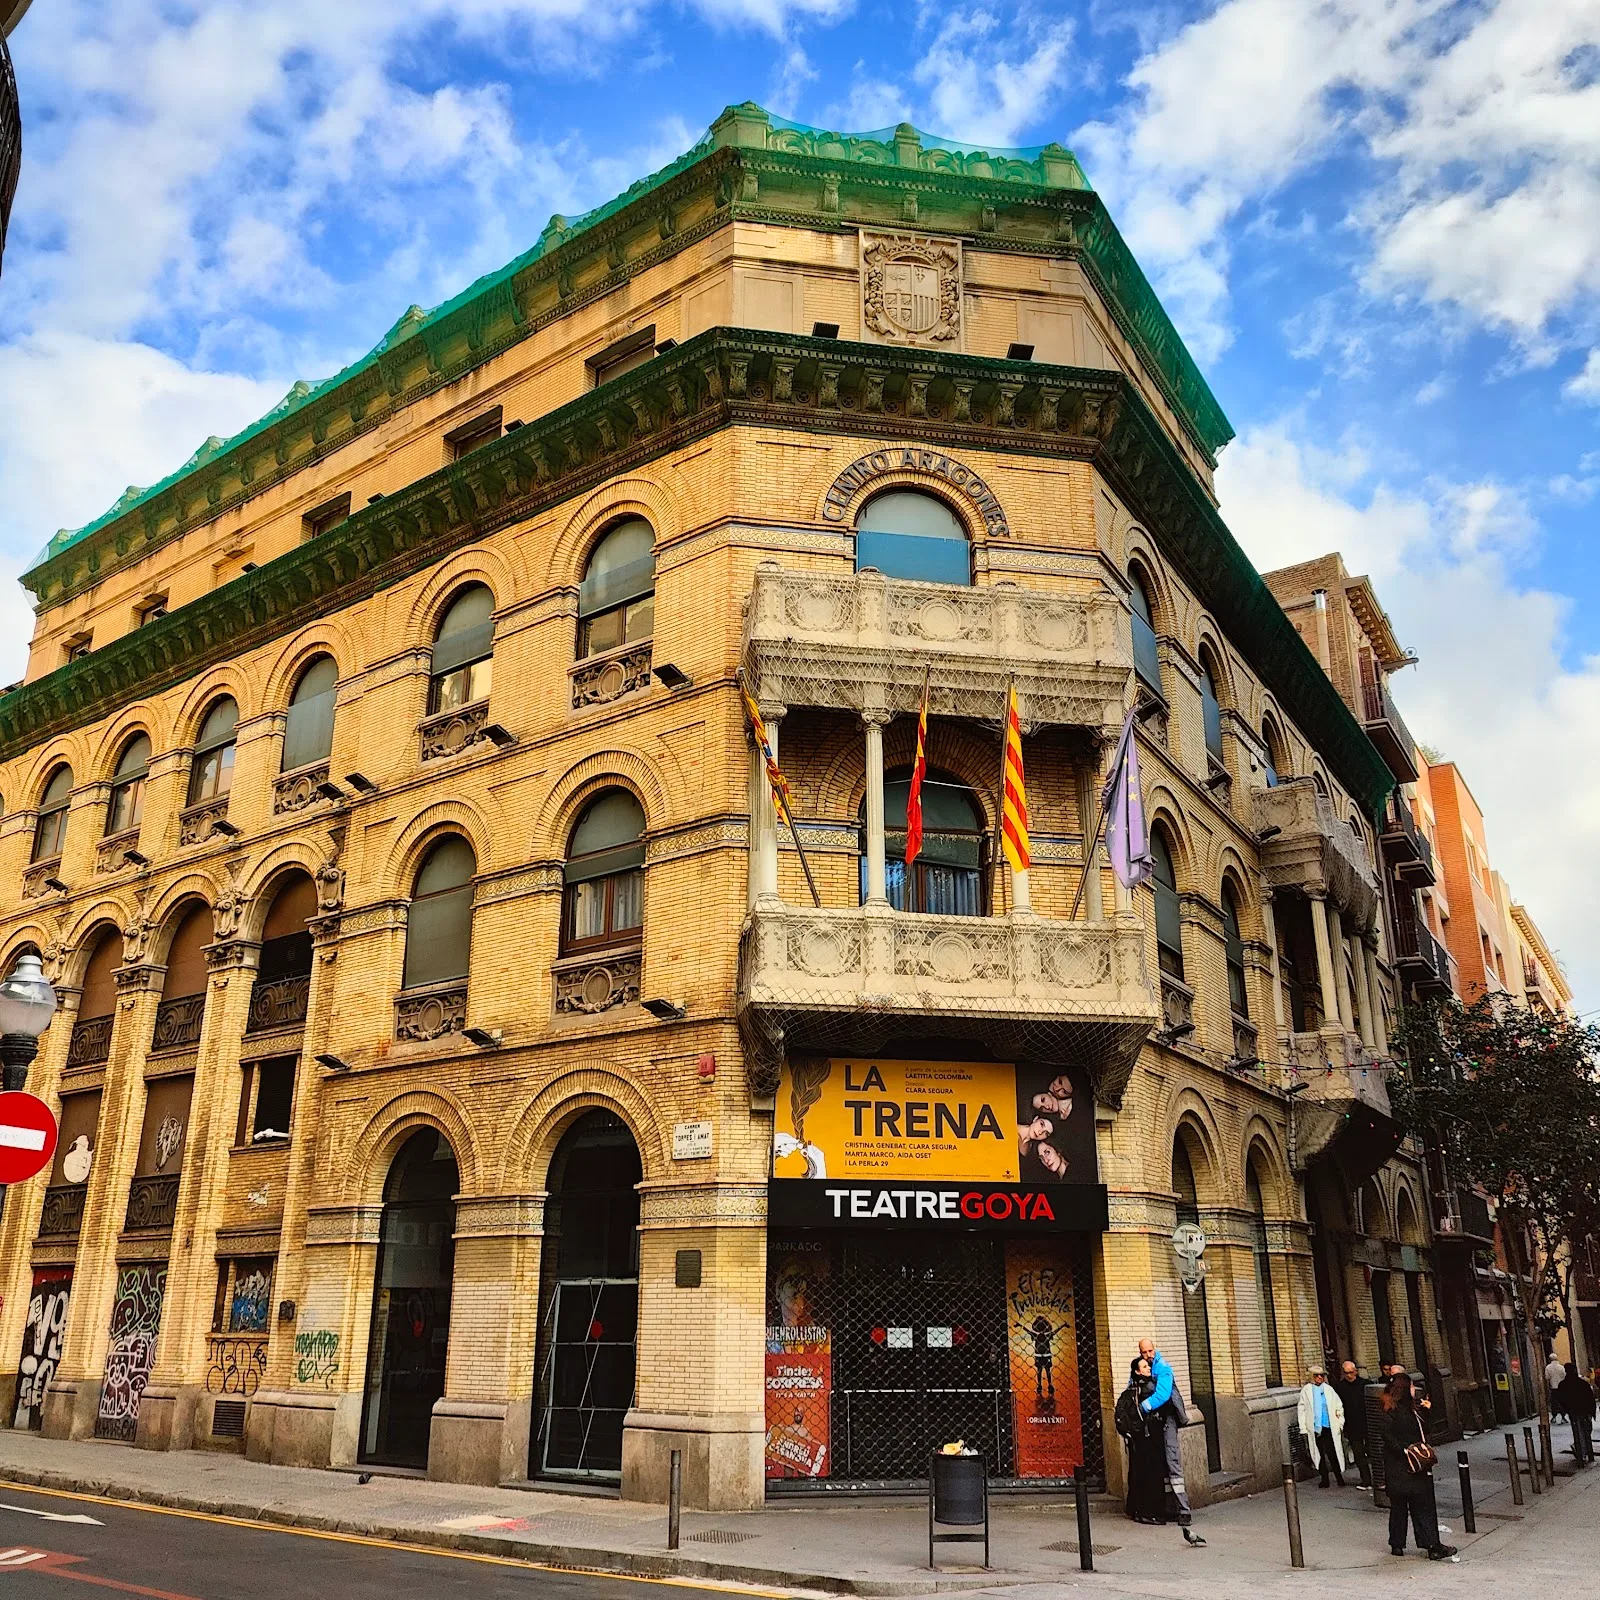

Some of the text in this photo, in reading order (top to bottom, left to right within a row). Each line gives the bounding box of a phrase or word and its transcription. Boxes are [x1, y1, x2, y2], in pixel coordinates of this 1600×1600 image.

[823, 448, 1010, 538] CENTRO ARAGONES
[844, 1065, 887, 1092] LA
[844, 1100, 1004, 1140] TRENA
[844, 1141, 875, 1149] CRISTINA
[875, 1142, 907, 1150] GENEBAT,
[931, 1143, 958, 1151] SEGURA
